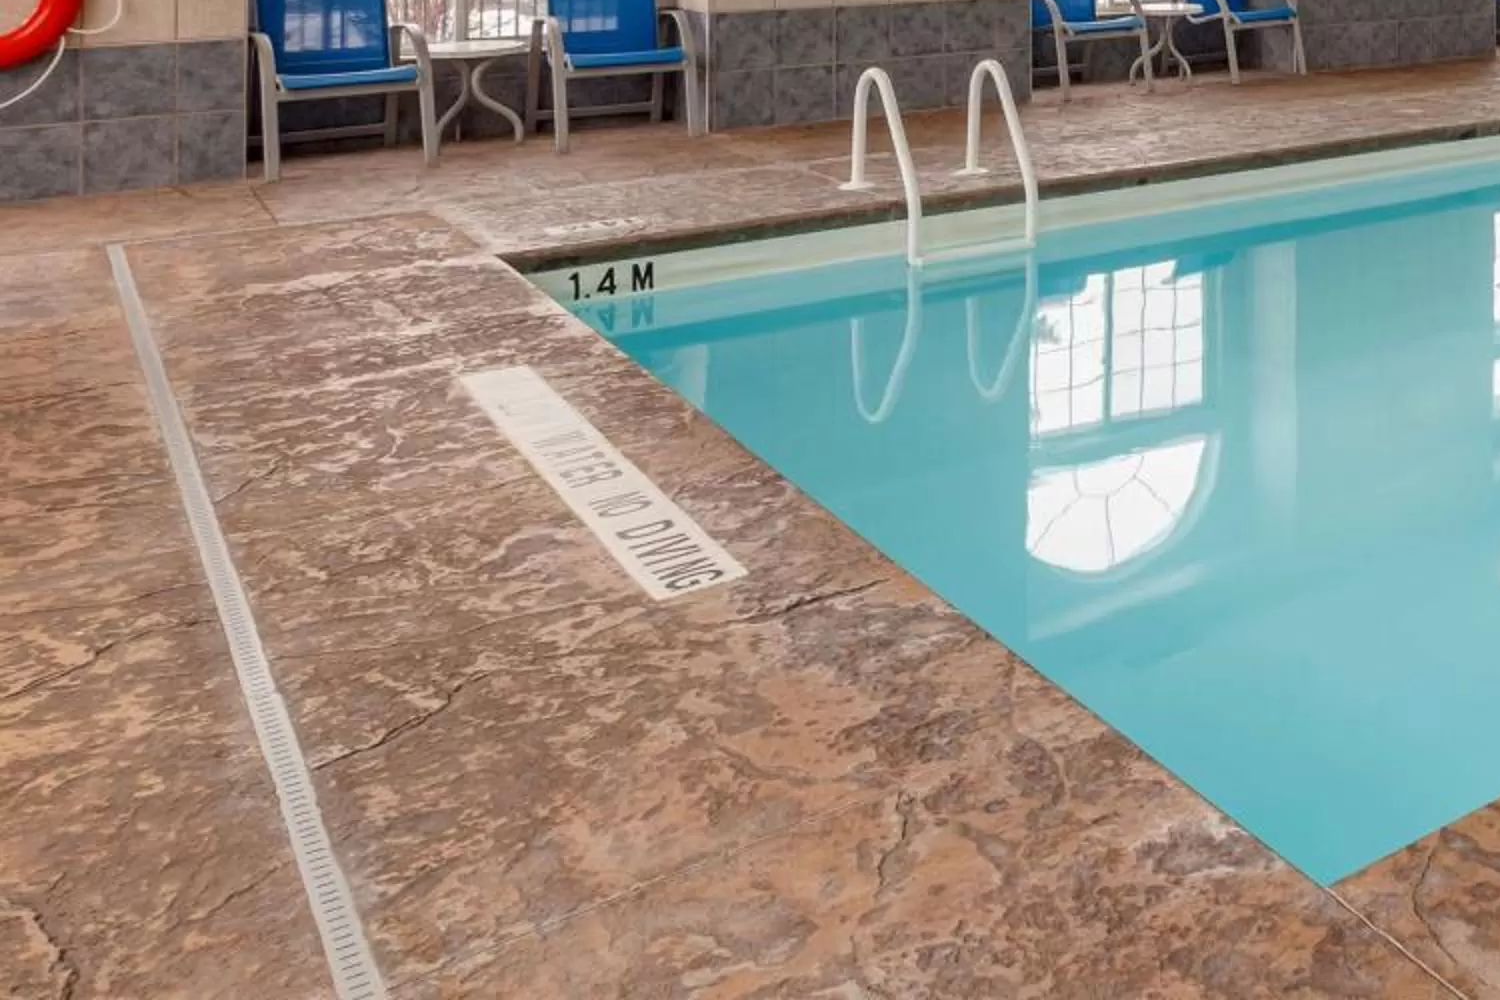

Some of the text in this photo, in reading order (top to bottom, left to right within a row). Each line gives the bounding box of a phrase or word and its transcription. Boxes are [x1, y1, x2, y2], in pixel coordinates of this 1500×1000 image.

[568, 261, 654, 301] 1.4 M
[587, 489, 653, 519] NO
[615, 518, 725, 593] DIVING
